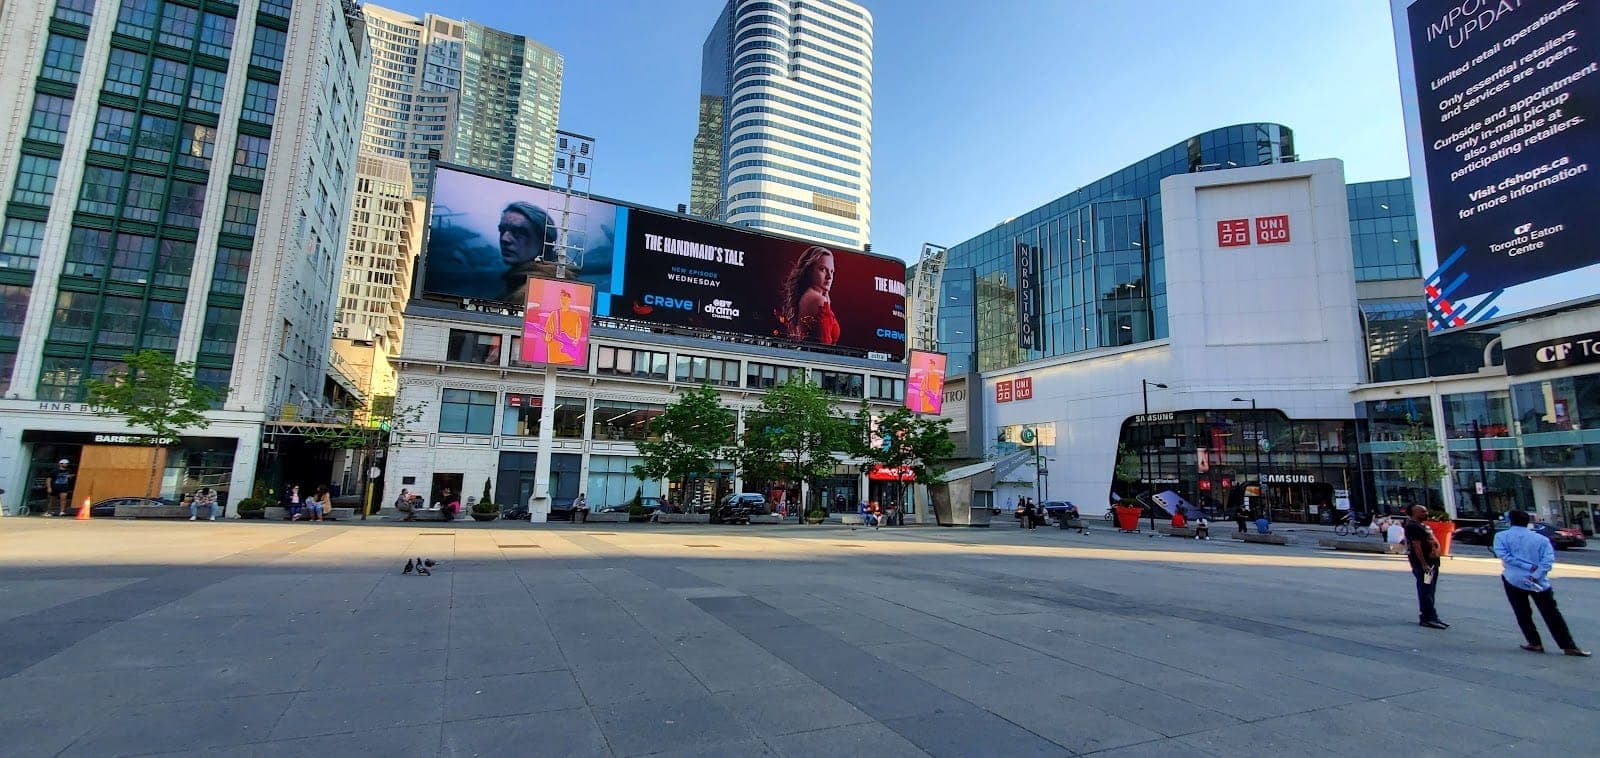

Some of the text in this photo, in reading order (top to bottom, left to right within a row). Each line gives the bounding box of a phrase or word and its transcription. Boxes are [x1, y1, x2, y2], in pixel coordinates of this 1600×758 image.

[1426, 0, 1486, 42] IMPO
[1431, 0, 1579, 91] Limited retail operations.
[1439, 29, 1576, 111] Only essential retailers
[1441, 45, 1577, 122] and services are open.
[1433, 61, 1598, 150] Curbside and appointment
[1455, 92, 1570, 153] only in-mall pickup
[1463, 109, 1562, 161] also available at
[1450, 115, 1584, 182] participating retailers.
[1468, 155, 1569, 202] Visit cfshops.ca
[1458, 163, 1588, 220] for more information
[1260, 219, 1283, 230] UNI
[1261, 229, 1287, 241] QLO
[1514, 222, 1532, 235] CF
[644, 233, 744, 266] THE HANDMAID'S TALE
[1489, 223, 1563, 253] Toronto Eaton
[1508, 240, 1544, 257] Centre
[667, 273, 720, 287] WEDNESDAY
[672, 266, 718, 278] NEW EPISODE
[874, 276, 888, 292] THE
[1021, 247, 1031, 345] NORDSTROM
[705, 304, 739, 317] drama
[1536, 342, 1572, 363] CF
[1016, 380, 1029, 389] UNI
[1016, 389, 1030, 398] QLO
[40, 402, 71, 411] HNR
[1260, 474, 1315, 483] SAMSUNG
